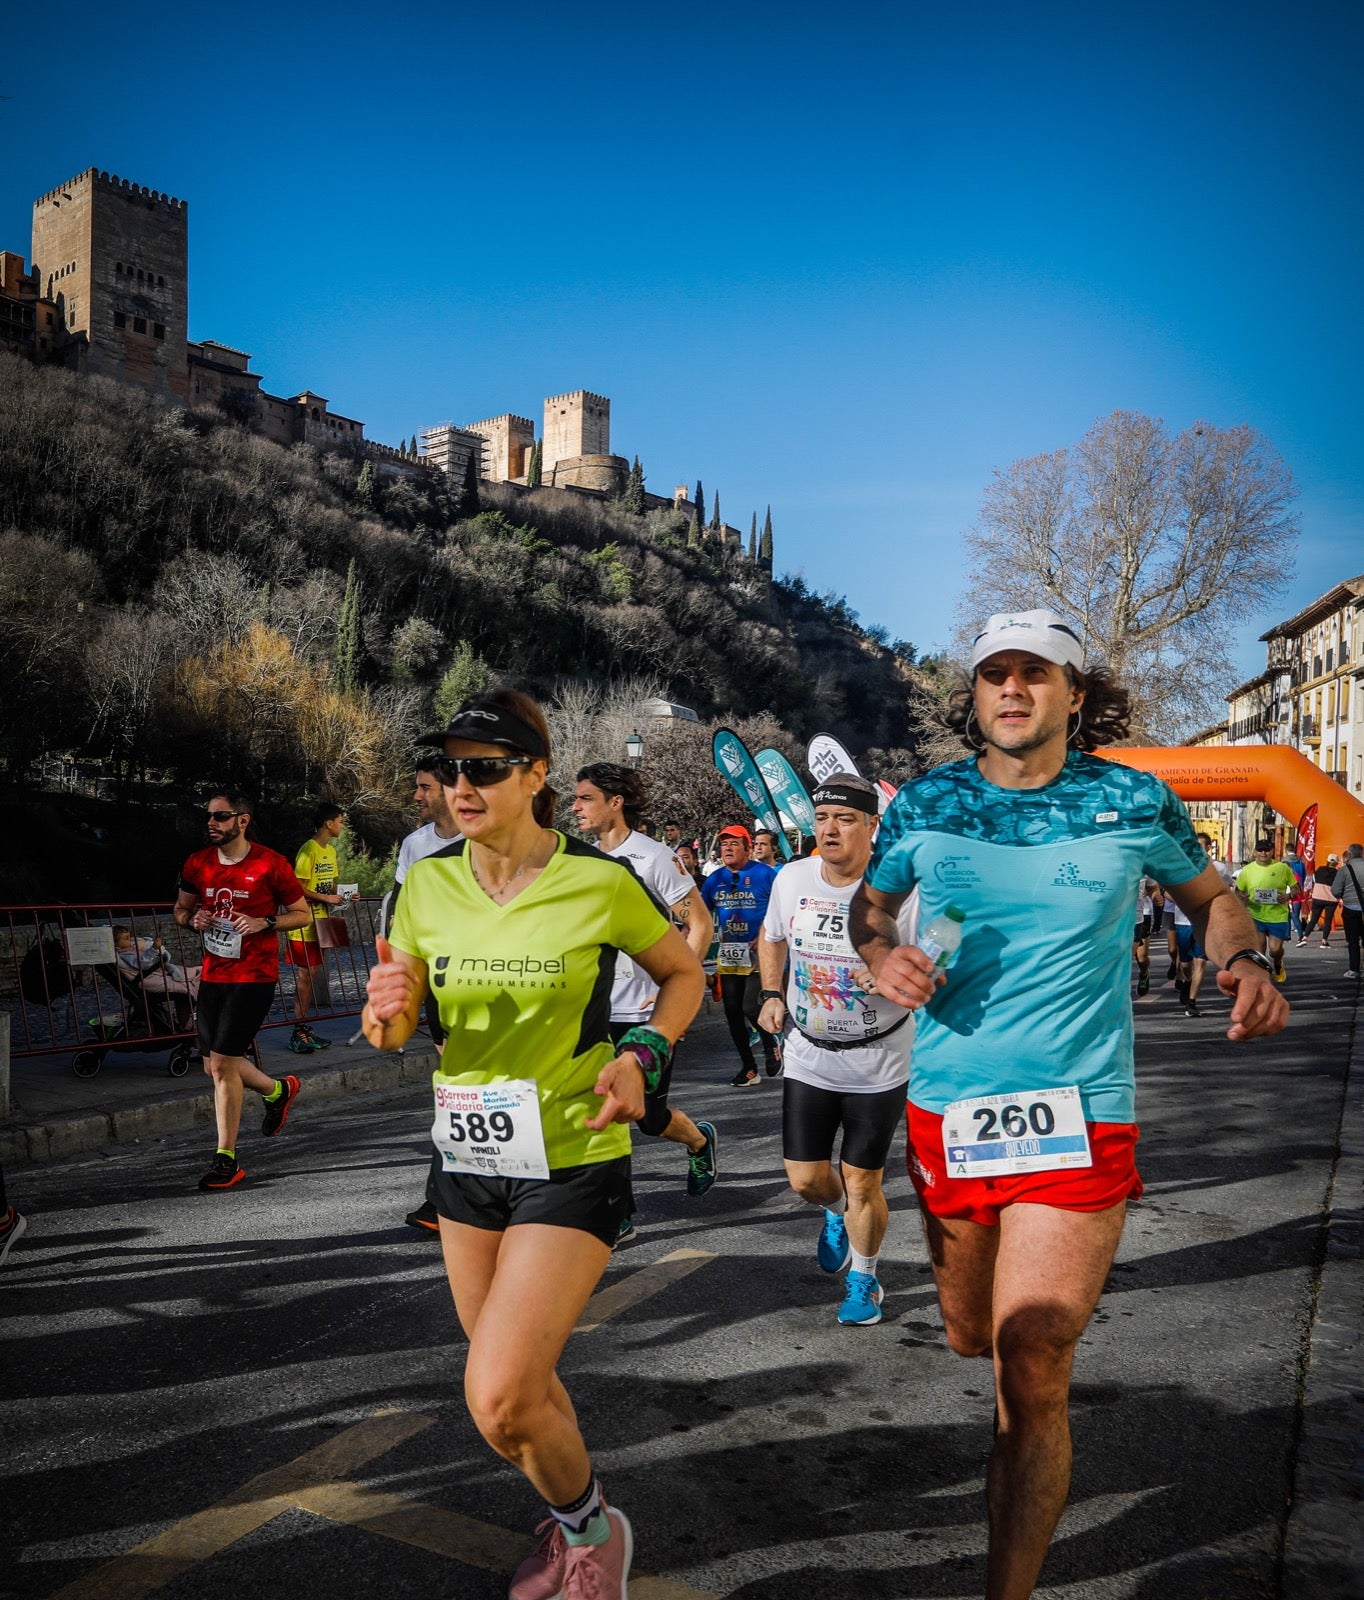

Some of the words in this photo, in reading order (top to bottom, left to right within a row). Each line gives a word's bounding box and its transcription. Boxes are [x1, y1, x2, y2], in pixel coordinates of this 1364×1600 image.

[1192, 775, 1204, 784] de
[1207, 775, 1249, 786] Deportes
[1070, 879, 1106, 888] GRUPO
[726, 891, 755, 900] MEDIA
[816, 913, 844, 933] 75
[812, 931, 828, 939] FRAN
[828, 933, 844, 941] LARA
[459, 954, 566, 978] maqbel
[457, 978, 567, 989] PERFUMERIAS
[827, 1019, 859, 1027] PUERTA
[827, 1025, 850, 1033] REAL
[444, 1089, 479, 1101] Carrera
[484, 1101, 521, 1111] Granada
[449, 1110, 515, 1143] 589
[972, 1101, 1056, 1142] 260
